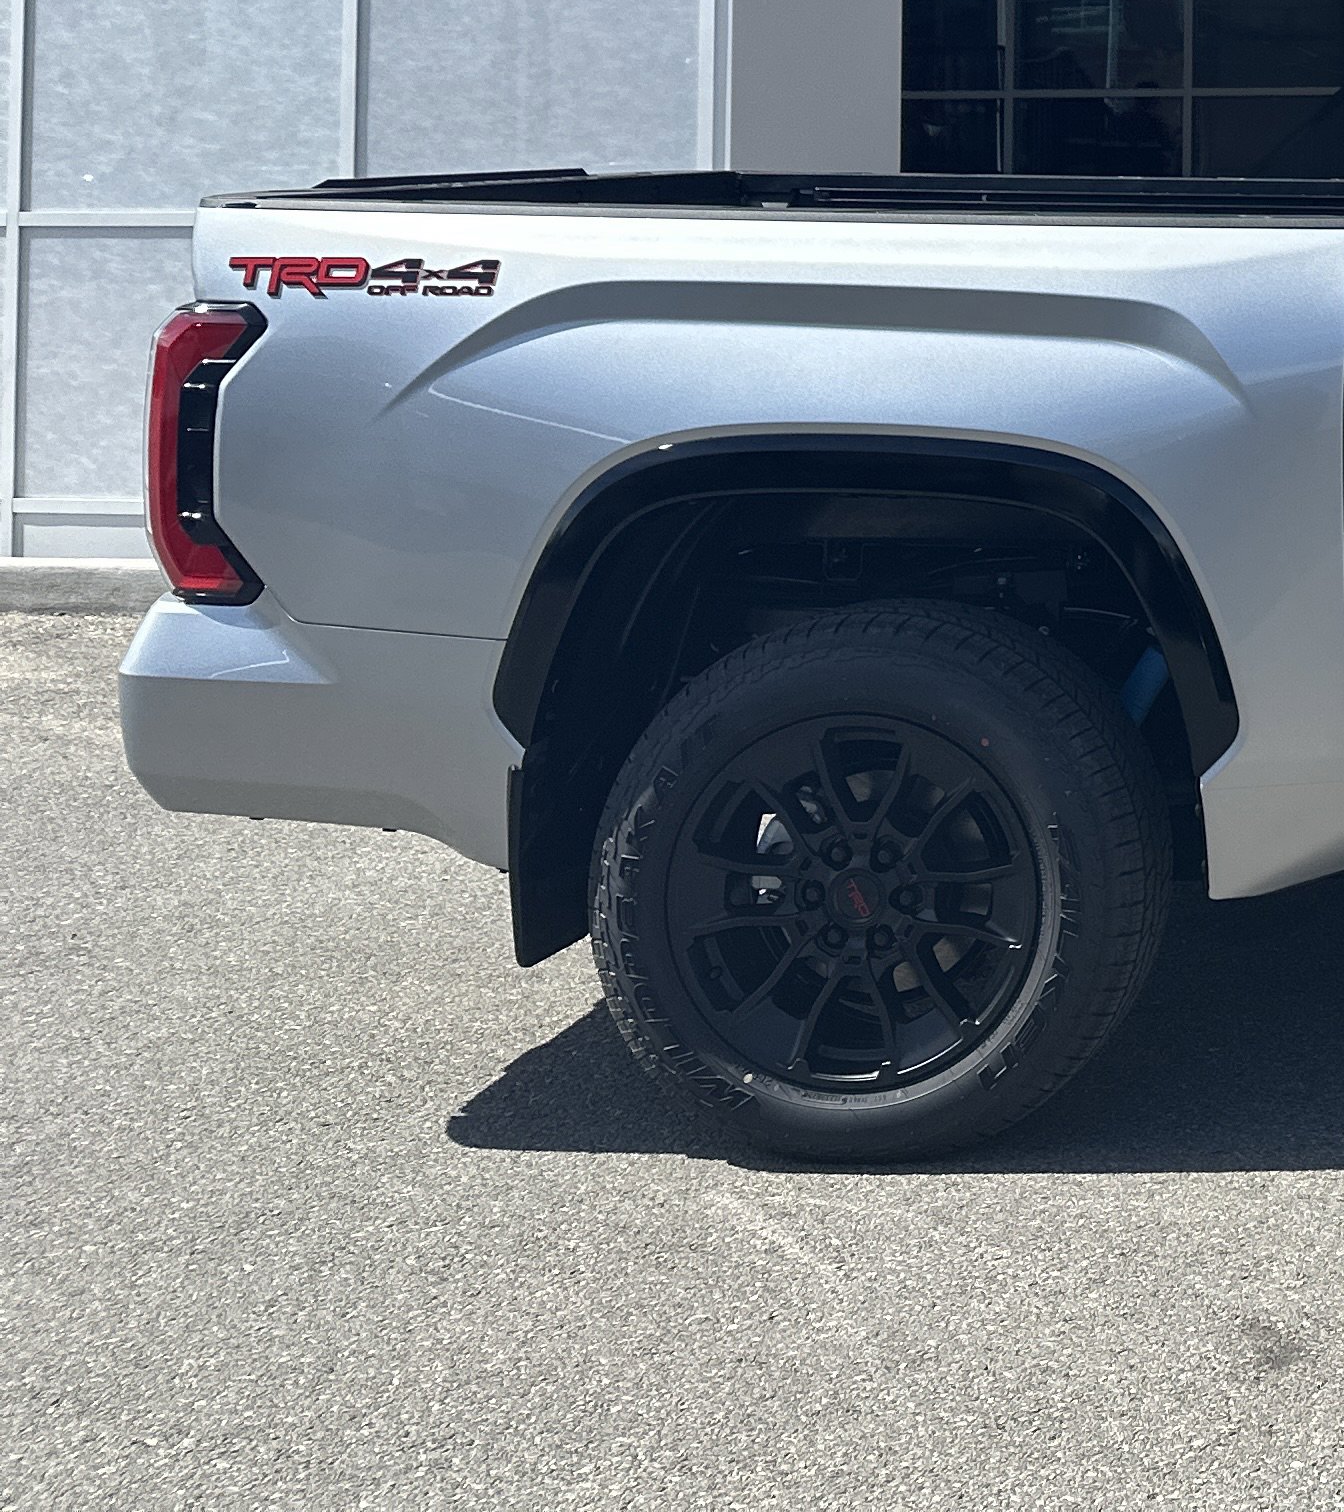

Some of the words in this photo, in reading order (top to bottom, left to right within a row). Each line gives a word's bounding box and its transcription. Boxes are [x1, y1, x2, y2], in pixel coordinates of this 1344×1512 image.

[229, 256, 372, 299] TRD
[370, 258, 501, 289] 4x4
[367, 284, 421, 297] OFF
[421, 285, 495, 298] ROAD
[848, 878, 870, 917] TRD
